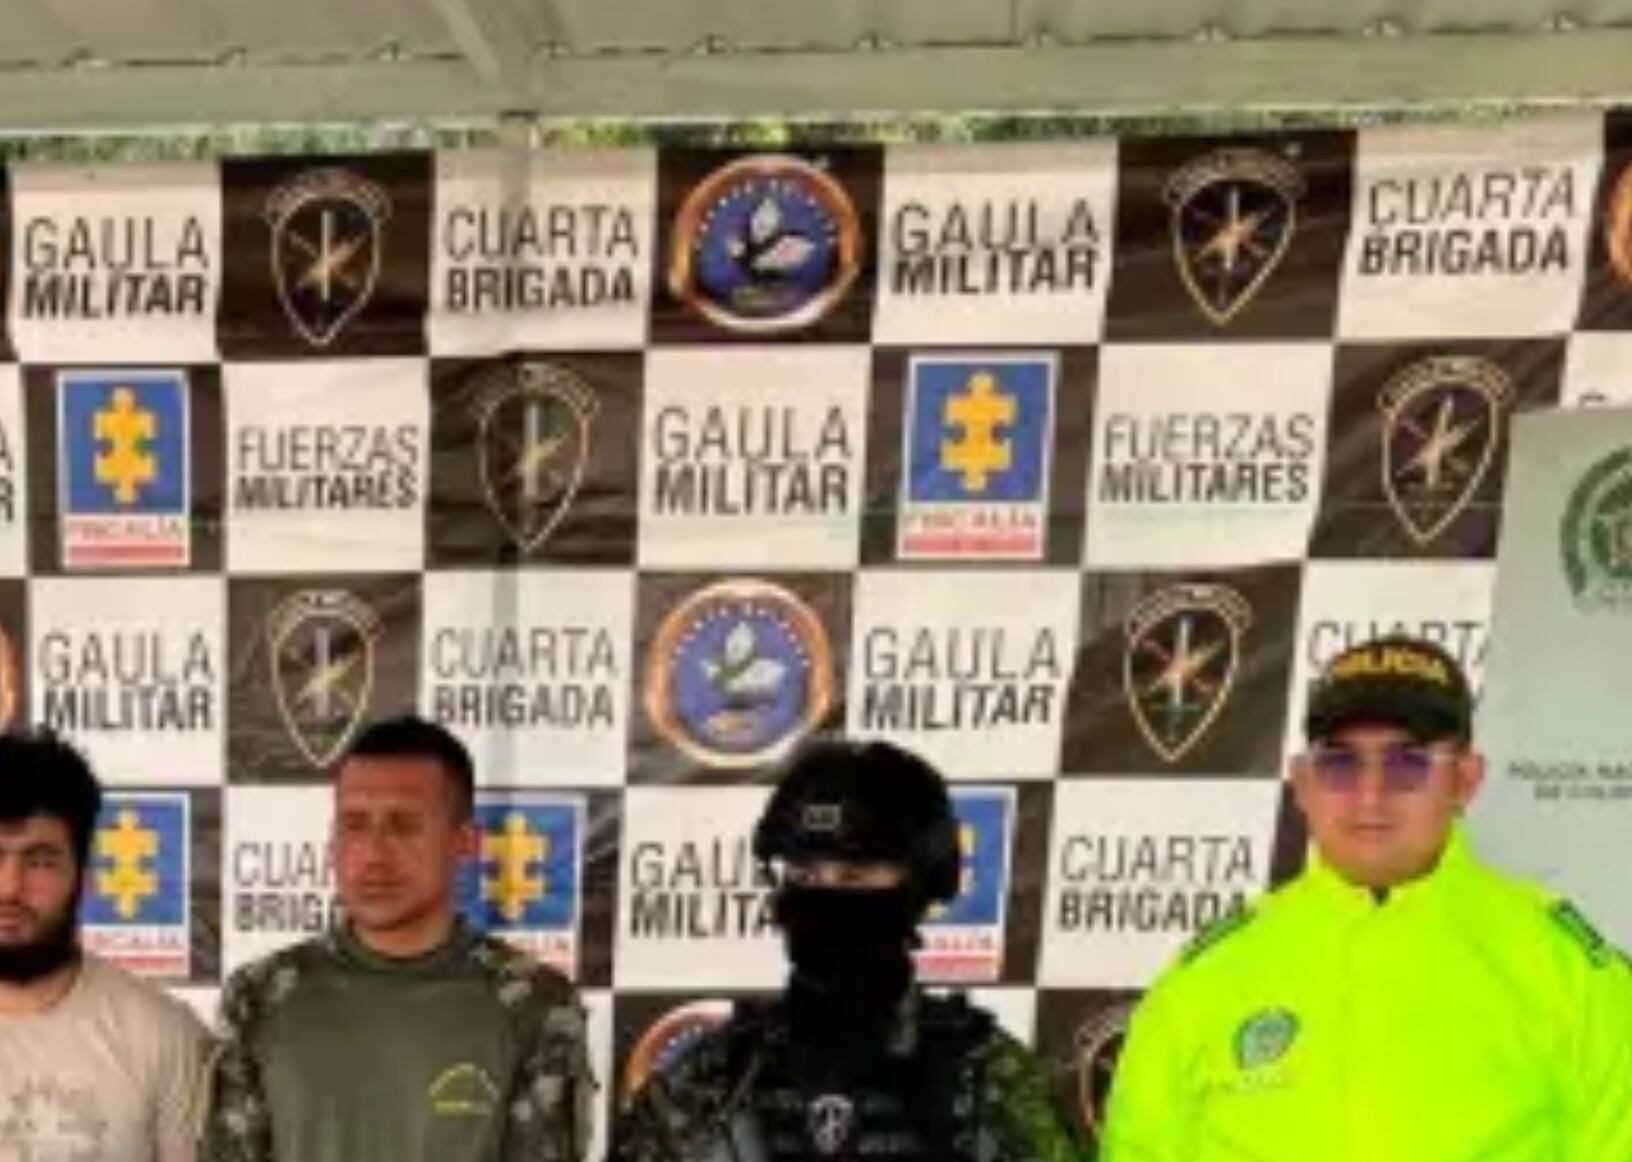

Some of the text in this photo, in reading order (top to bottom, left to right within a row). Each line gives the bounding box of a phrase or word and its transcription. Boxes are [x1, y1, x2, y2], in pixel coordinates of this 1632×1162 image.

[1369, 167, 1575, 224] CUARTA
[24, 215, 208, 271] GAULA
[444, 204, 638, 260] CUARTA
[895, 199, 1098, 255] GAULA
[892, 246, 1097, 294] MILITAR
[1359, 229, 1569, 275] BRIGADA
[23, 273, 206, 319] MILITAR
[446, 267, 635, 312] BRIGADA
[238, 424, 418, 471] FUERZAS
[655, 405, 851, 460] GAULA
[1105, 413, 1315, 461] FUERZAS
[235, 472, 418, 509] MILITARES
[653, 463, 848, 515] MILITAR
[1100, 462, 1308, 503] MILITARES
[40, 632, 213, 684] GAULA
[433, 627, 617, 678] CUARTA
[865, 627, 1061, 679] GAULA
[45, 687, 212, 730] MILITAR
[434, 684, 614, 728] BRIGADA
[861, 683, 1055, 729] MILITAR
[234, 842, 328, 887] CUA
[632, 837, 745, 887] GAU
[1060, 836, 1254, 882] CUARTA
[234, 892, 322, 932] BRIG
[631, 892, 777, 938] MILITA
